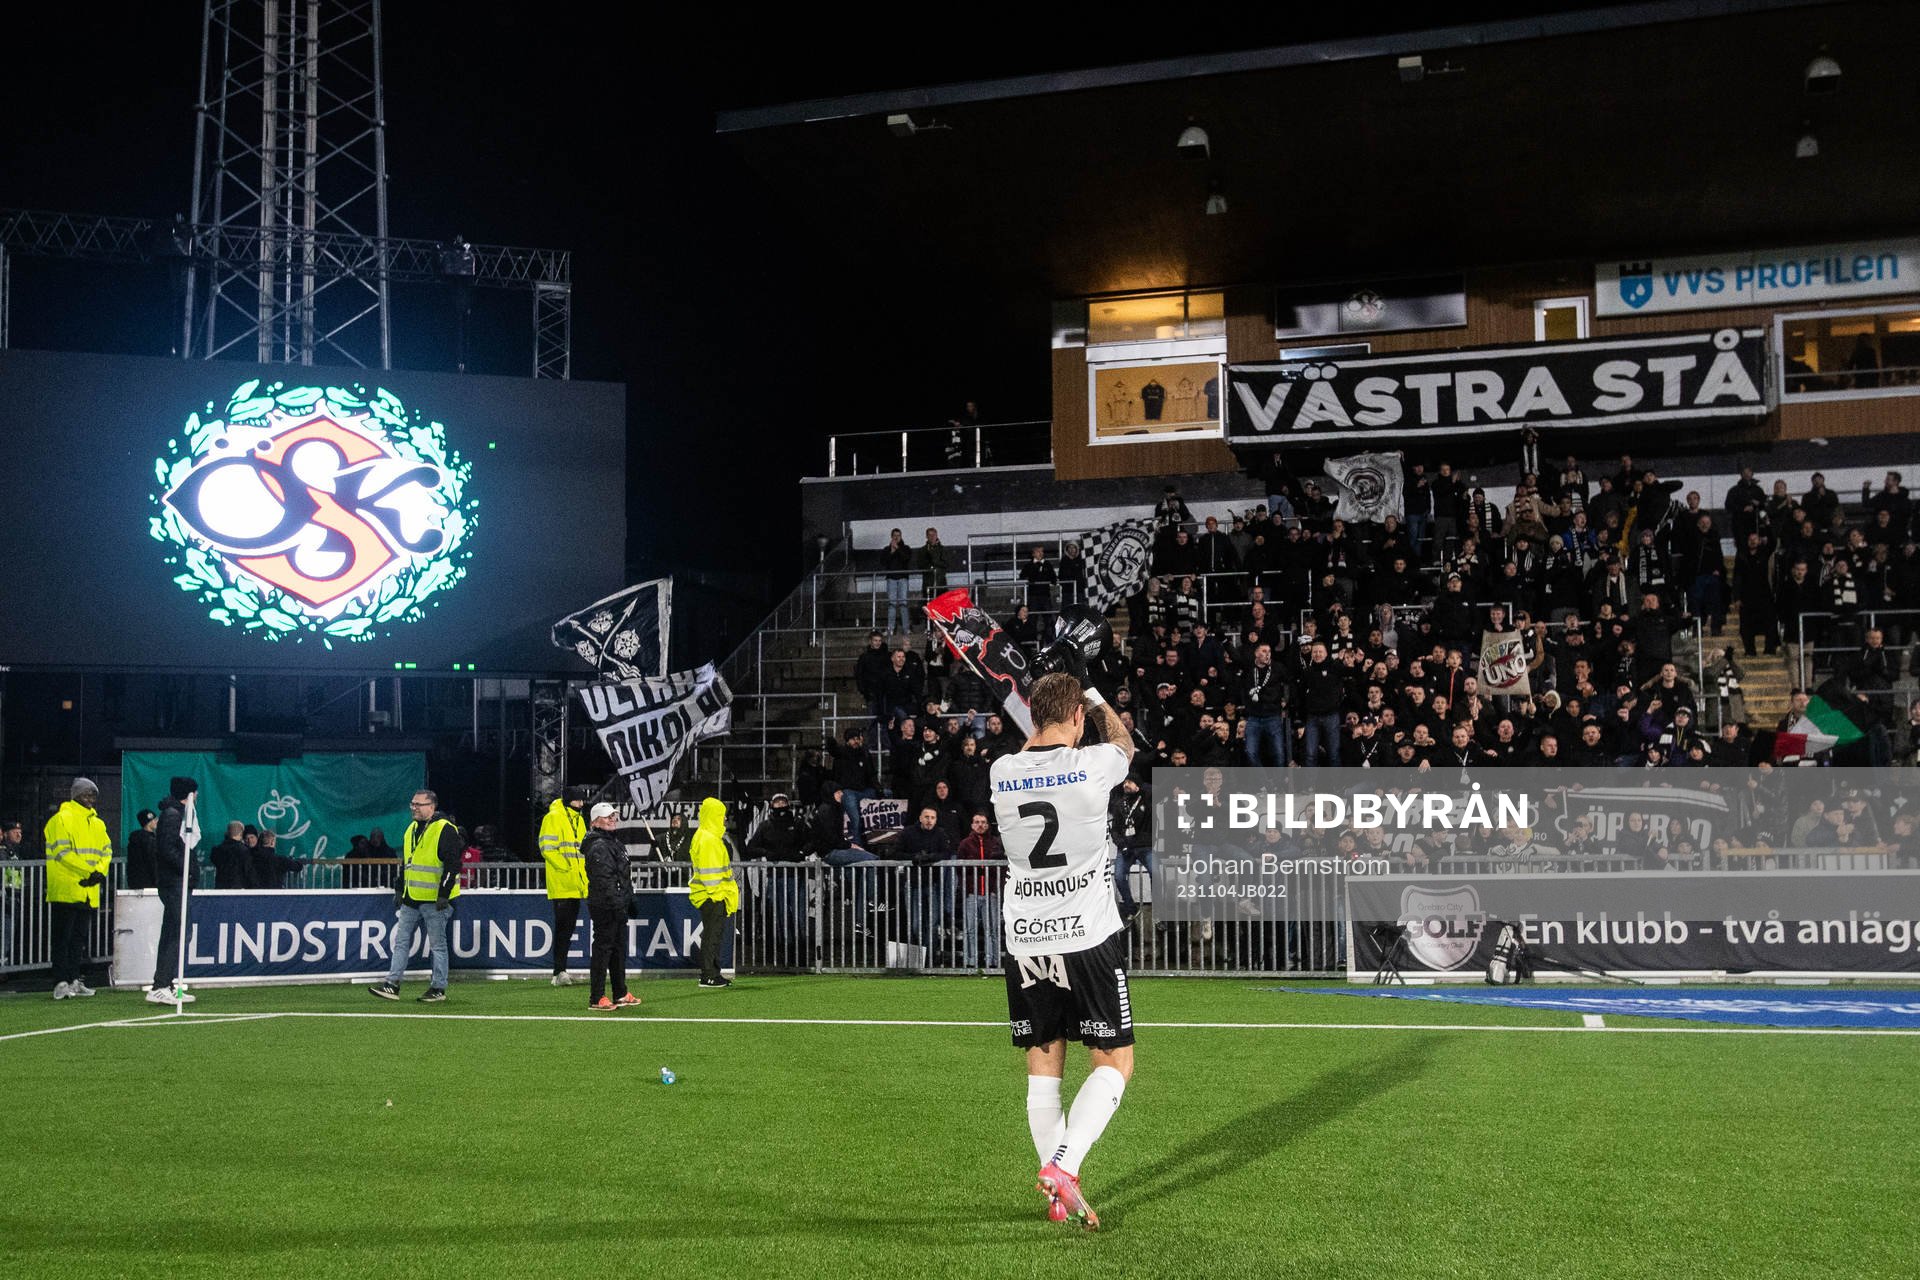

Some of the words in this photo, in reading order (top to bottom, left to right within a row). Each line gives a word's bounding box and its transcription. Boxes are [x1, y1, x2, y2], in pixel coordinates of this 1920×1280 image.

[1661, 268, 1726, 298] VVS
[1232, 362, 1572, 432] VÄSTRA
[1591, 328, 1761, 411] STÅ
[1482, 654, 1528, 686] UNO
[997, 770, 1088, 793] MALMBERGS
[859, 801, 899, 816] ollektiv
[1017, 801, 1068, 869] 2
[1014, 870, 1096, 900] BJÖRNQUIST
[1416, 903, 1446, 911] Örebro
[1446, 903, 1464, 912] City
[1013, 915, 1084, 935] GÖRTZ
[1014, 932, 1069, 943] FASTIGHETER
[1070, 929, 1086, 938] AB
[1406, 914, 1483, 939] GOLF
[1519, 914, 1565, 944] En
[1576, 911, 1689, 944] klubb
[1724, 910, 1785, 945] två
